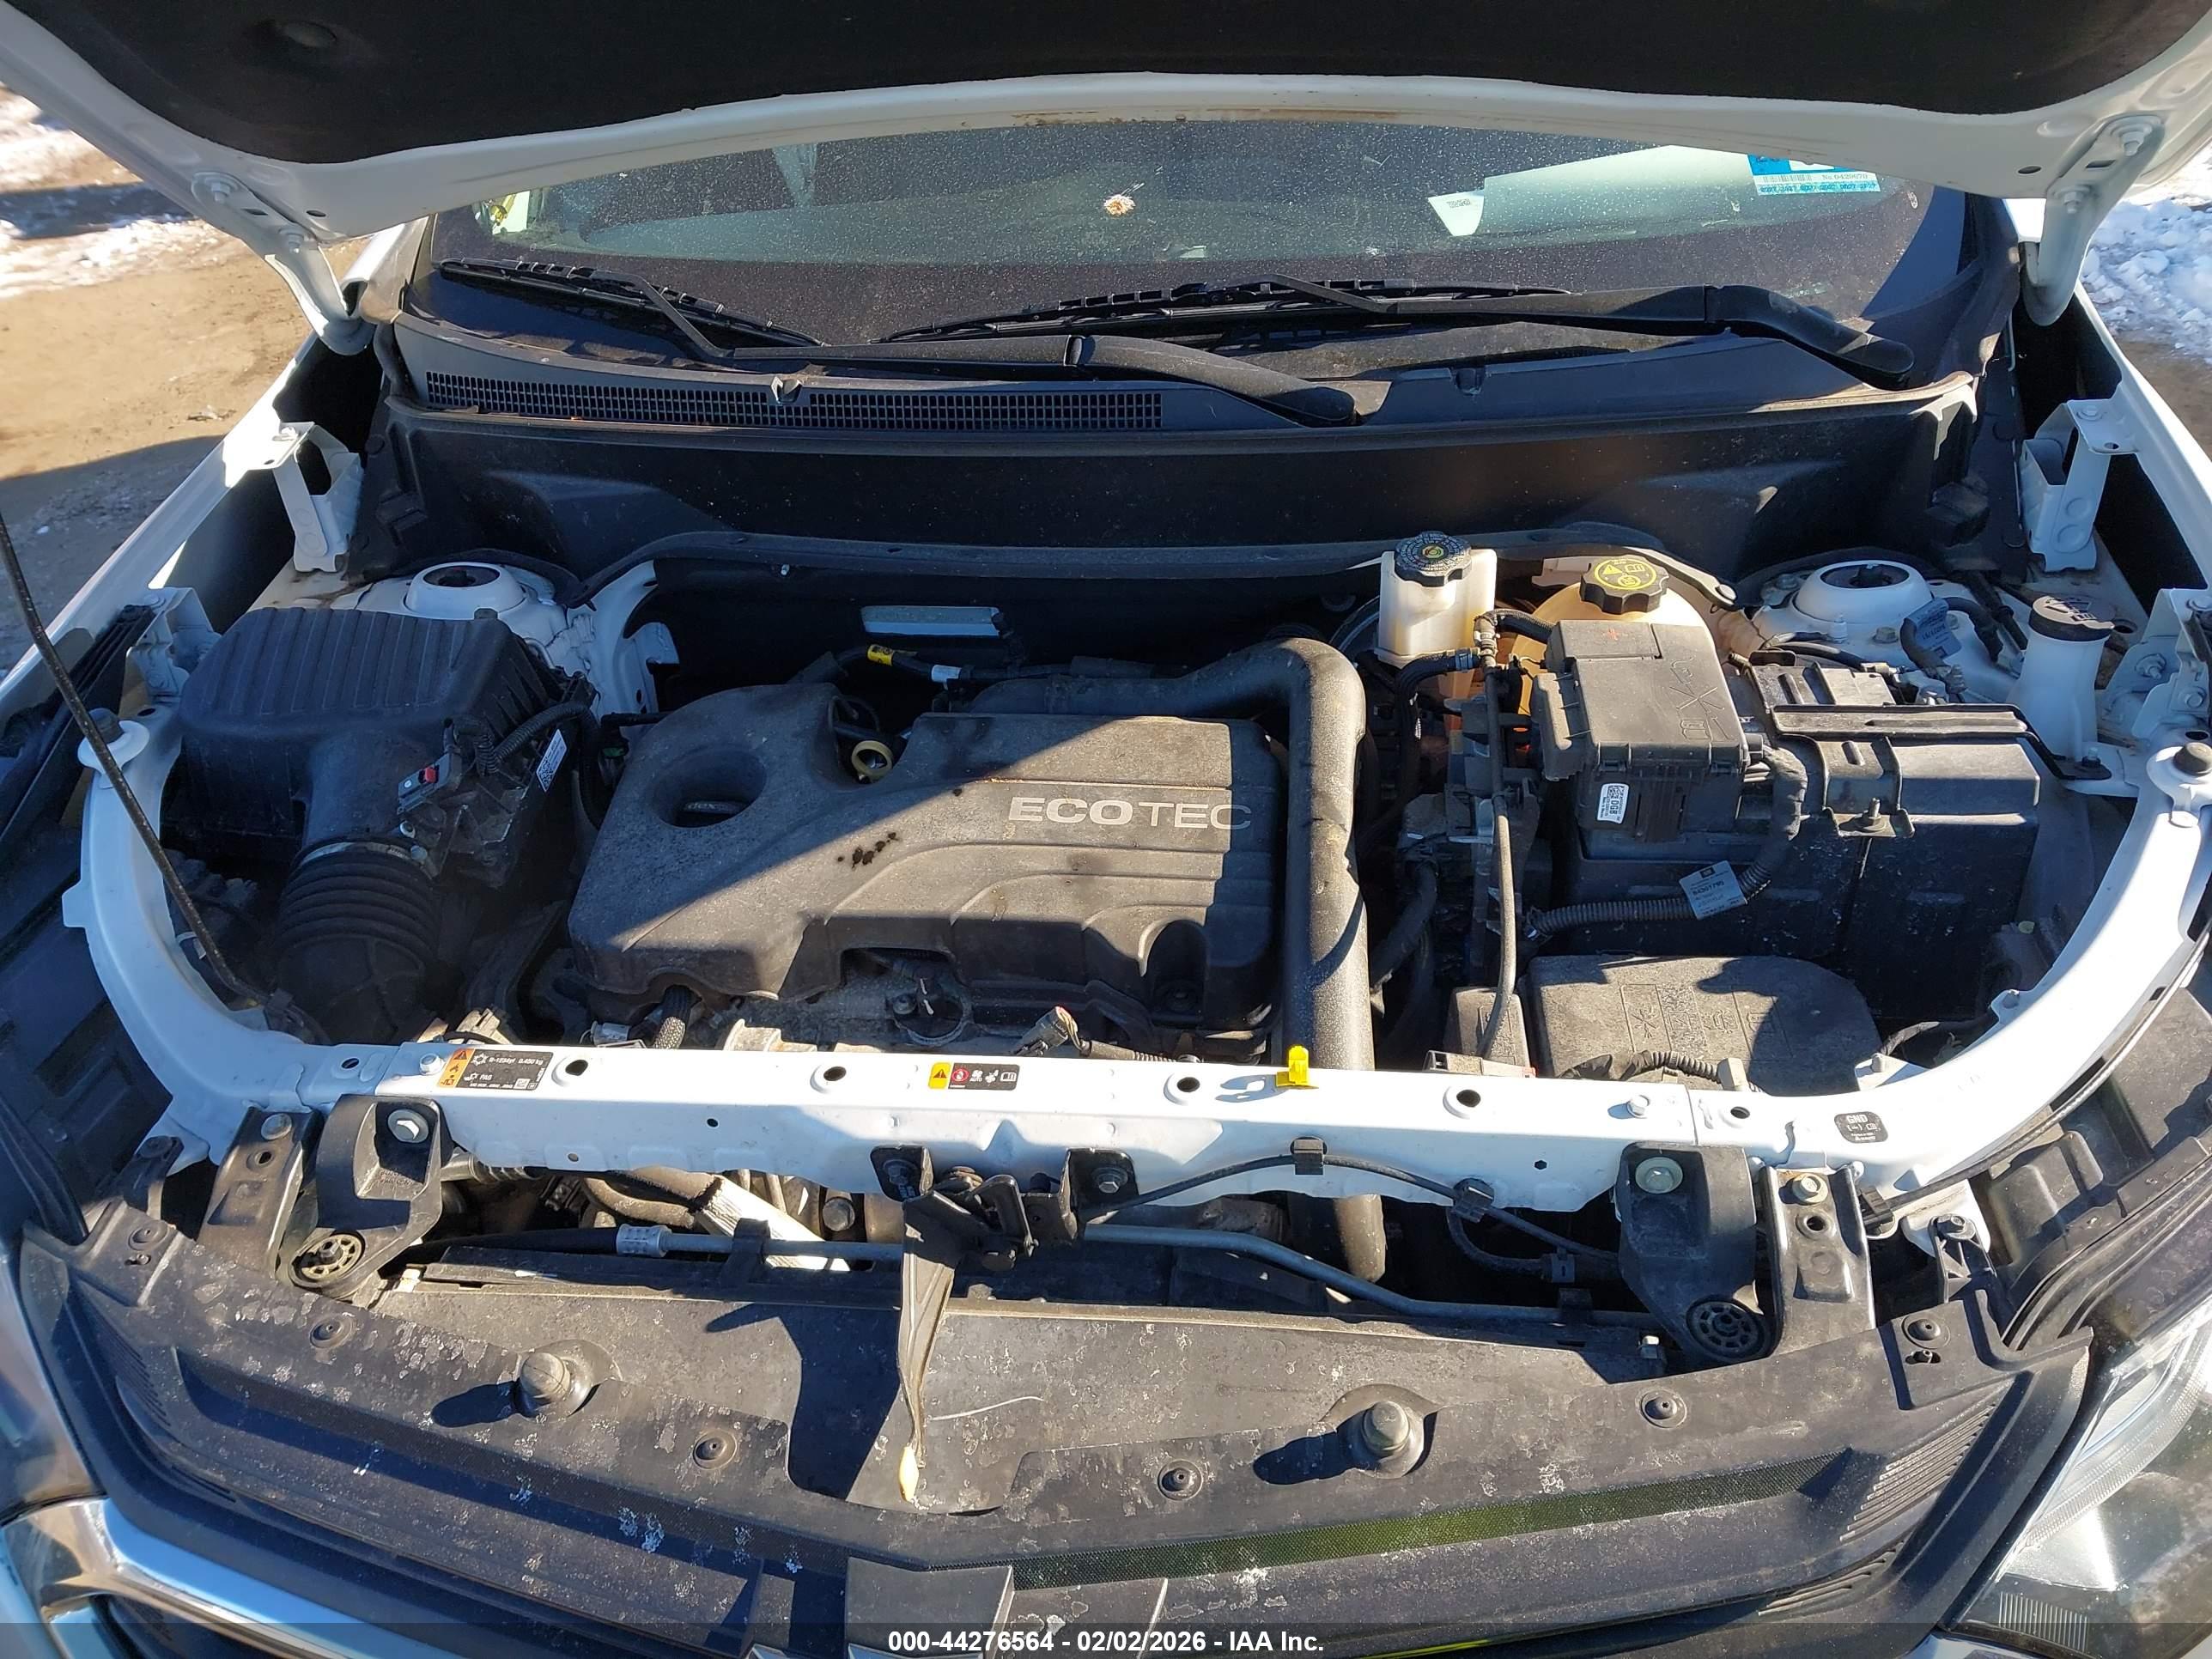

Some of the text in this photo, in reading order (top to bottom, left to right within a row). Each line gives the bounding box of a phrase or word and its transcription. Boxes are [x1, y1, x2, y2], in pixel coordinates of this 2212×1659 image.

[1008, 797, 1252, 830] ECOTEC
[1610, 800, 1619, 815] DGB
[489, 1056, 516, 1065] R-1234yf
[1846, 1114, 1869, 1124] GND
